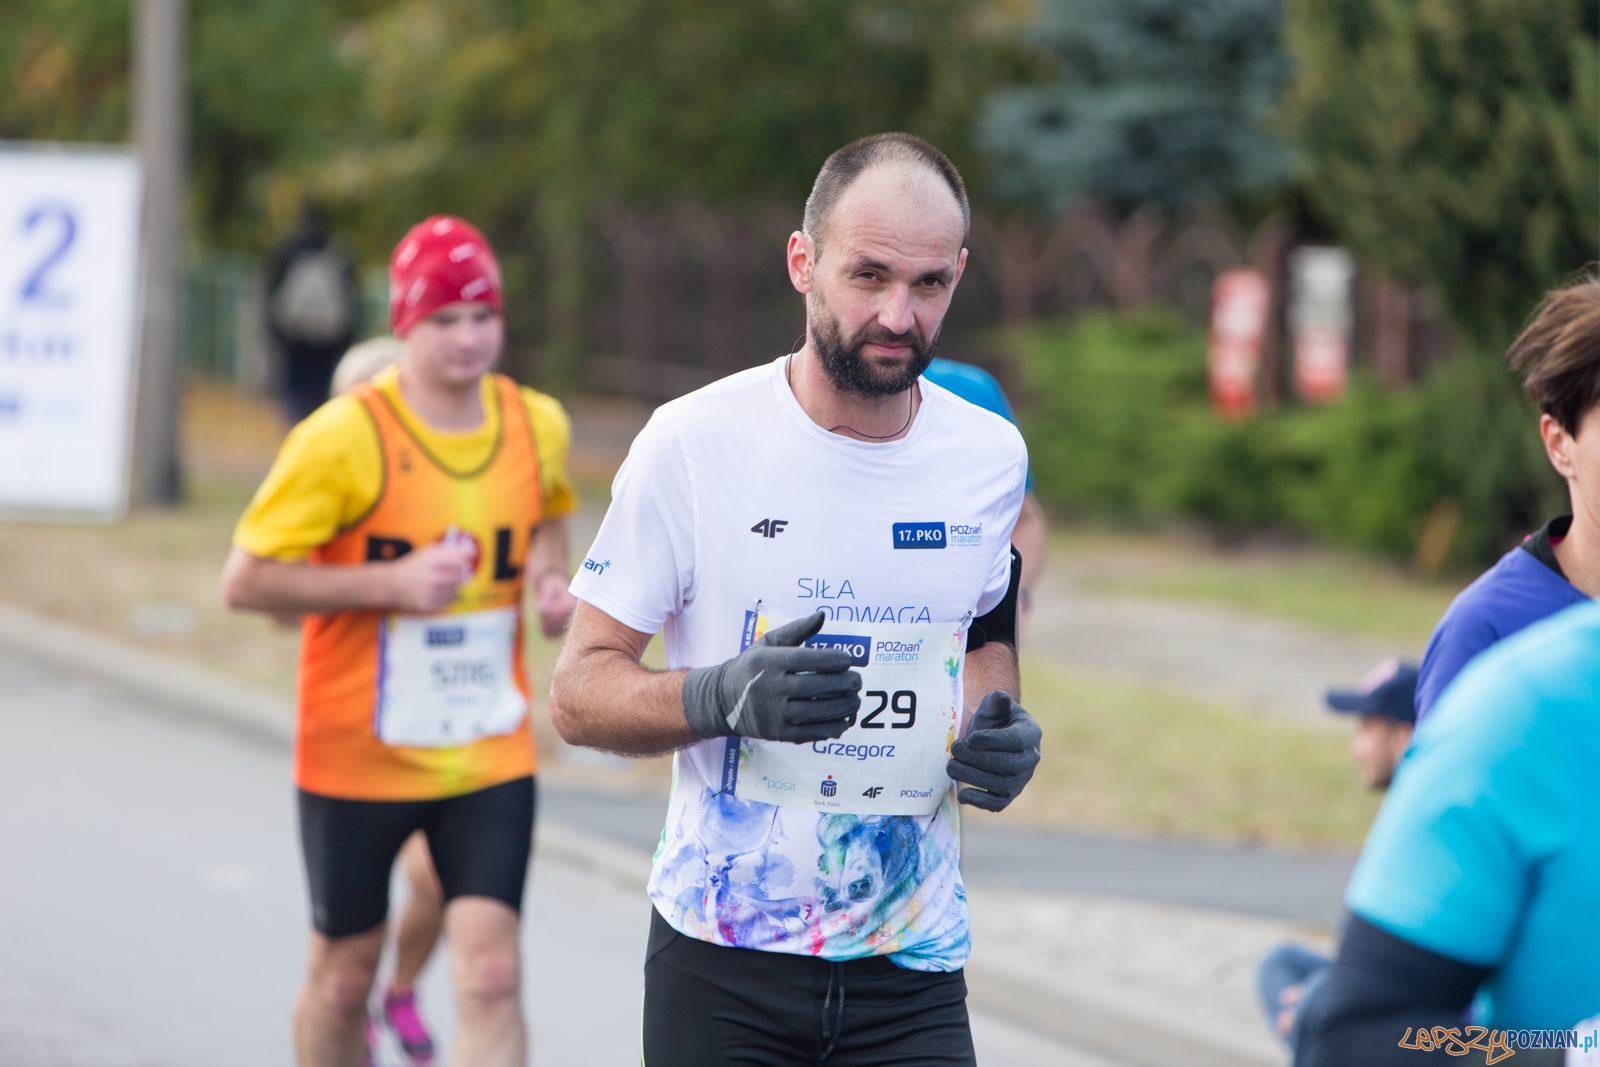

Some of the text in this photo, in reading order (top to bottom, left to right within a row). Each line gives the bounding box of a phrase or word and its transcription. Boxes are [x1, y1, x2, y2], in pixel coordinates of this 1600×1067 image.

[750, 518, 788, 538] 4F
[898, 529, 942, 541] 17. PKO
[797, 578, 855, 599] SIŁA
[875, 651, 919, 662] maraton
[850, 690, 917, 729] 29
[812, 740, 896, 761] Grzegorz
[862, 787, 884, 799] 4F
